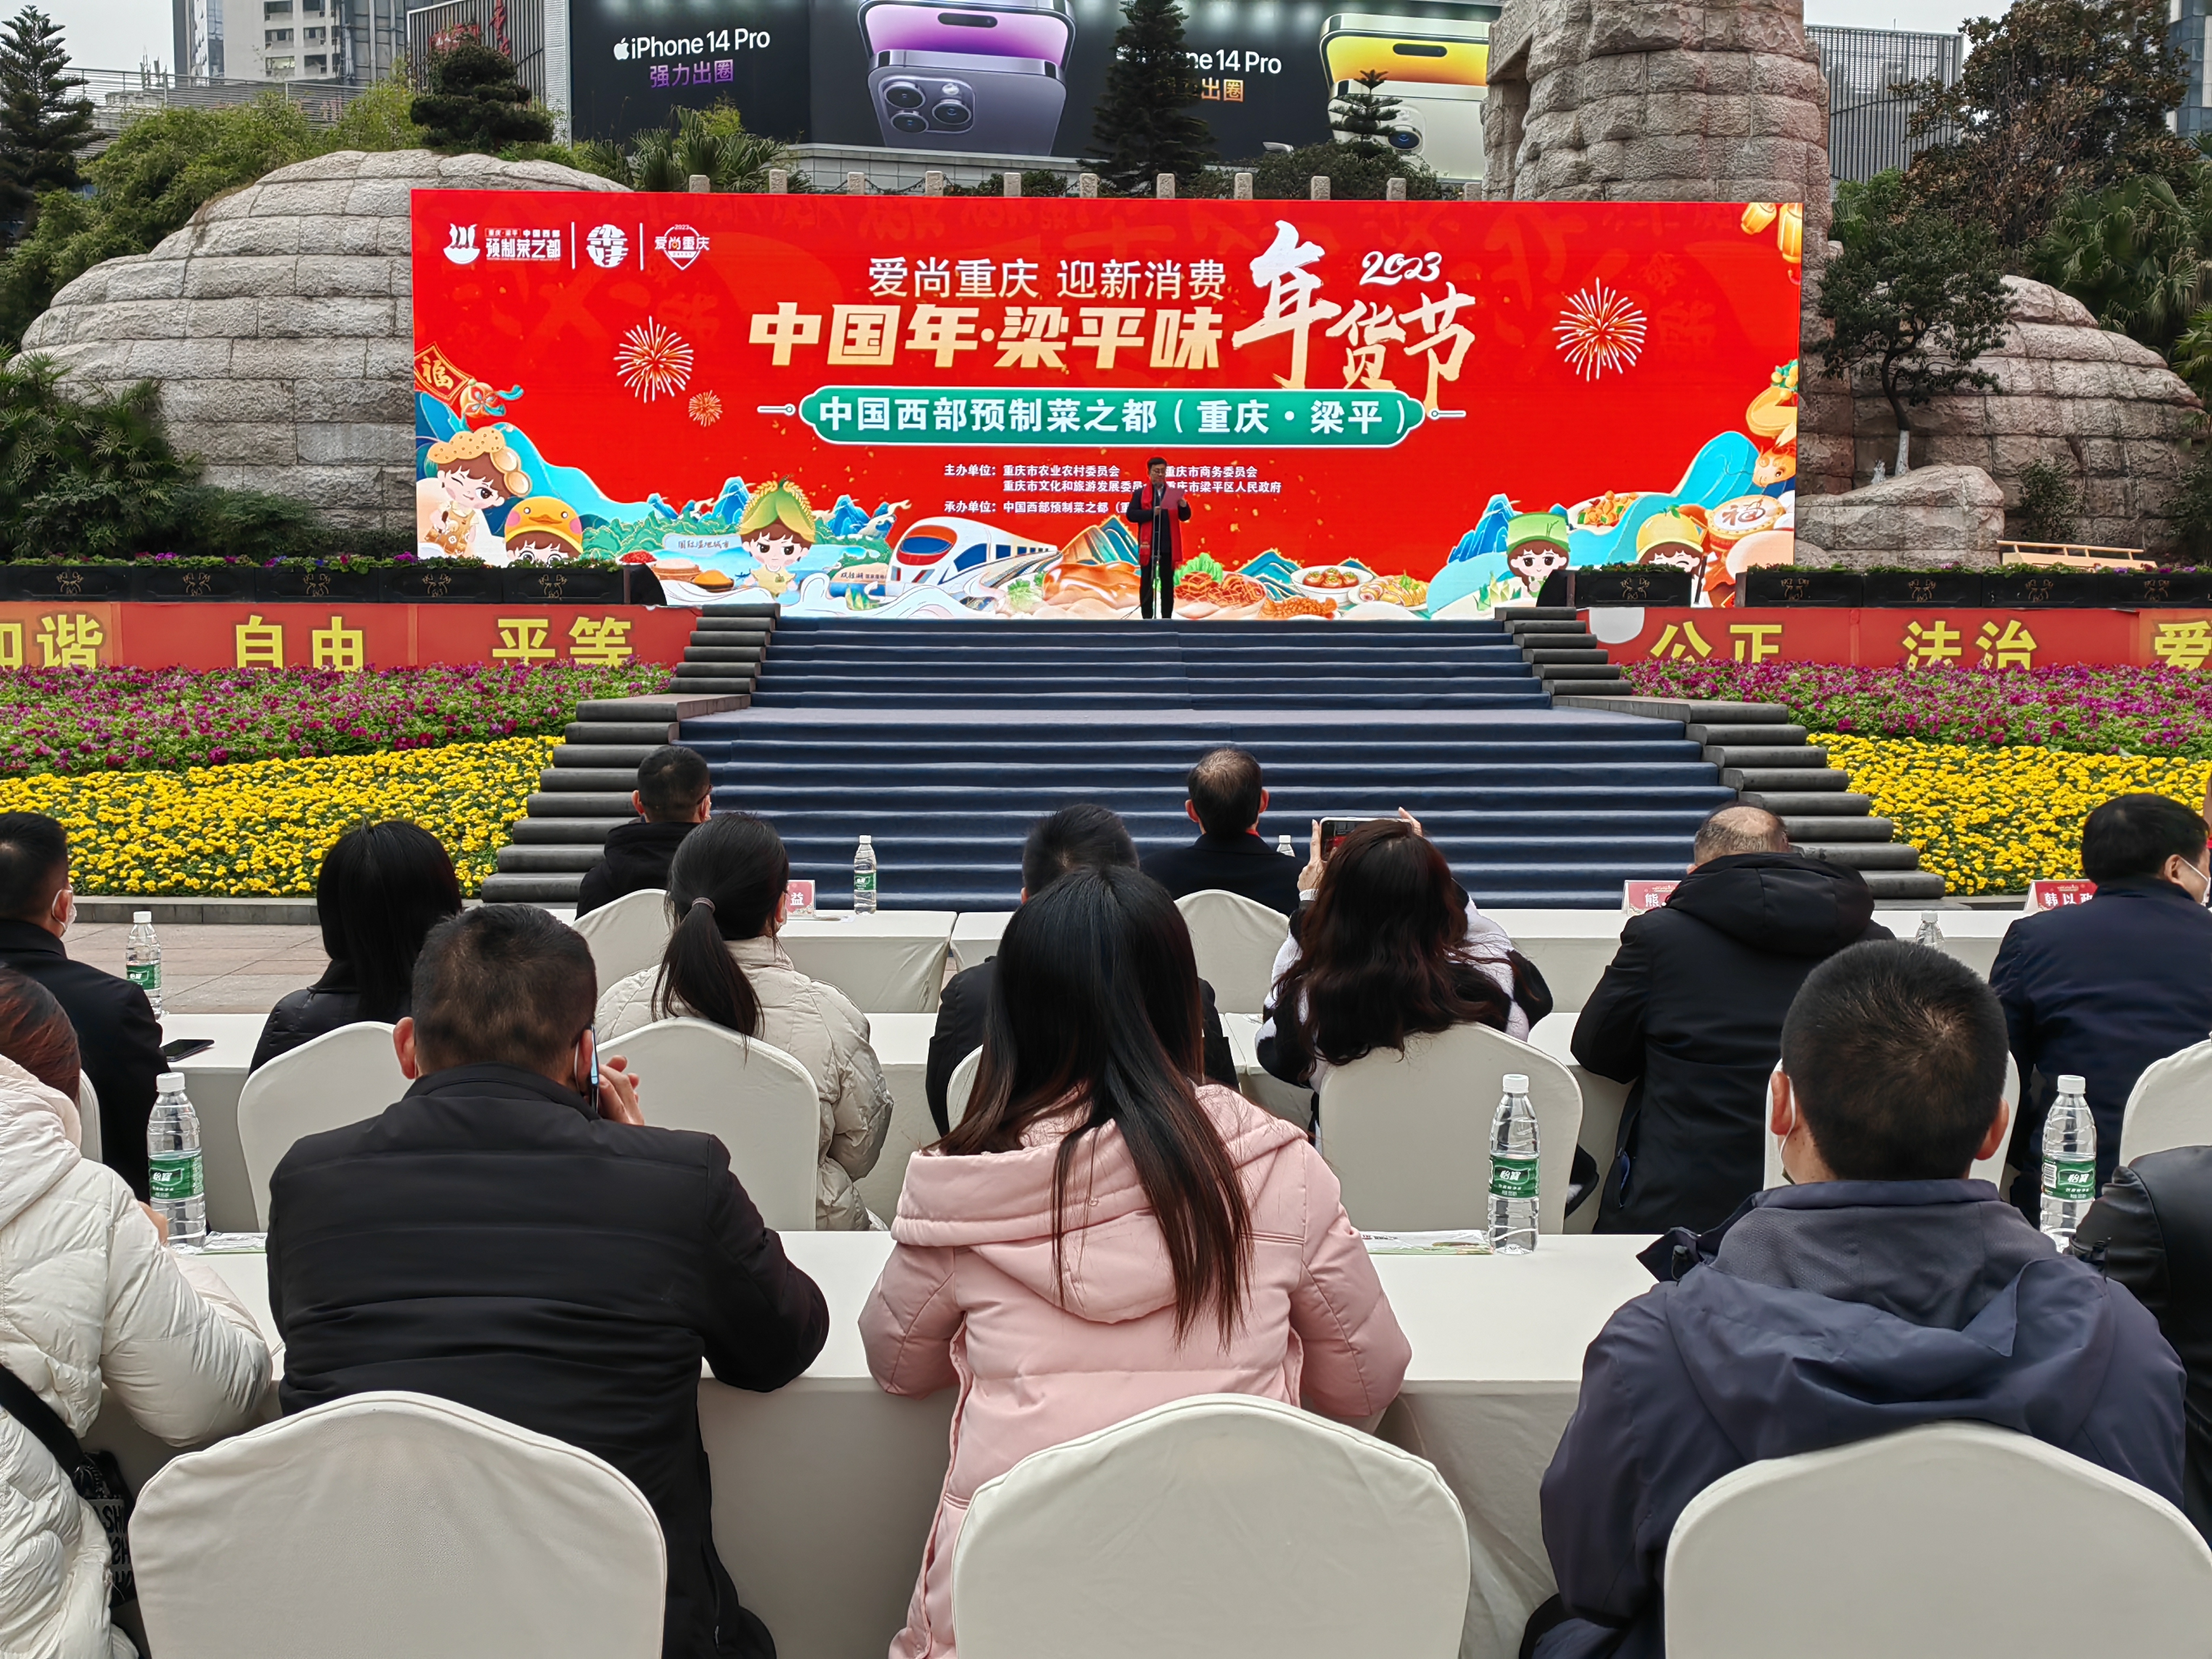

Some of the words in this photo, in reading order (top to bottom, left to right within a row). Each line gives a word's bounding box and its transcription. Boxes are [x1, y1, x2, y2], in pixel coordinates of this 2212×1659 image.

[631, 35, 703, 59] iPhone
[706, 30, 730, 52] 14
[735, 28, 771, 50] Pro
[650, 59, 734, 89] 强力出圈
[1216, 49, 1240, 71] 14
[1245, 51, 1282, 75] Pro
[485, 238, 561, 258] 预制菜之都
[655, 236, 710, 251] 爱尚重庆
[868, 257, 1039, 298] 爱尚重庆
[1057, 259, 1226, 300] 迎新消费
[1359, 251, 1442, 286] 2023
[748, 301, 1223, 369] 中国年·梁平味
[1232, 219, 1475, 416] 年货节
[421, 355, 454, 390] 福
[1003, 464, 1121, 477] 重庆市农业农村委员会
[1165, 465, 1258, 478] 重庆市商务委员会
[1003, 480, 1147, 493] 重庆市文化和旅游发展委员
[235, 615, 364, 671] 自由
[492, 616, 633, 666] 平等
[1650, 621, 1783, 663] 公正
[1902, 619, 2037, 670] 法治
